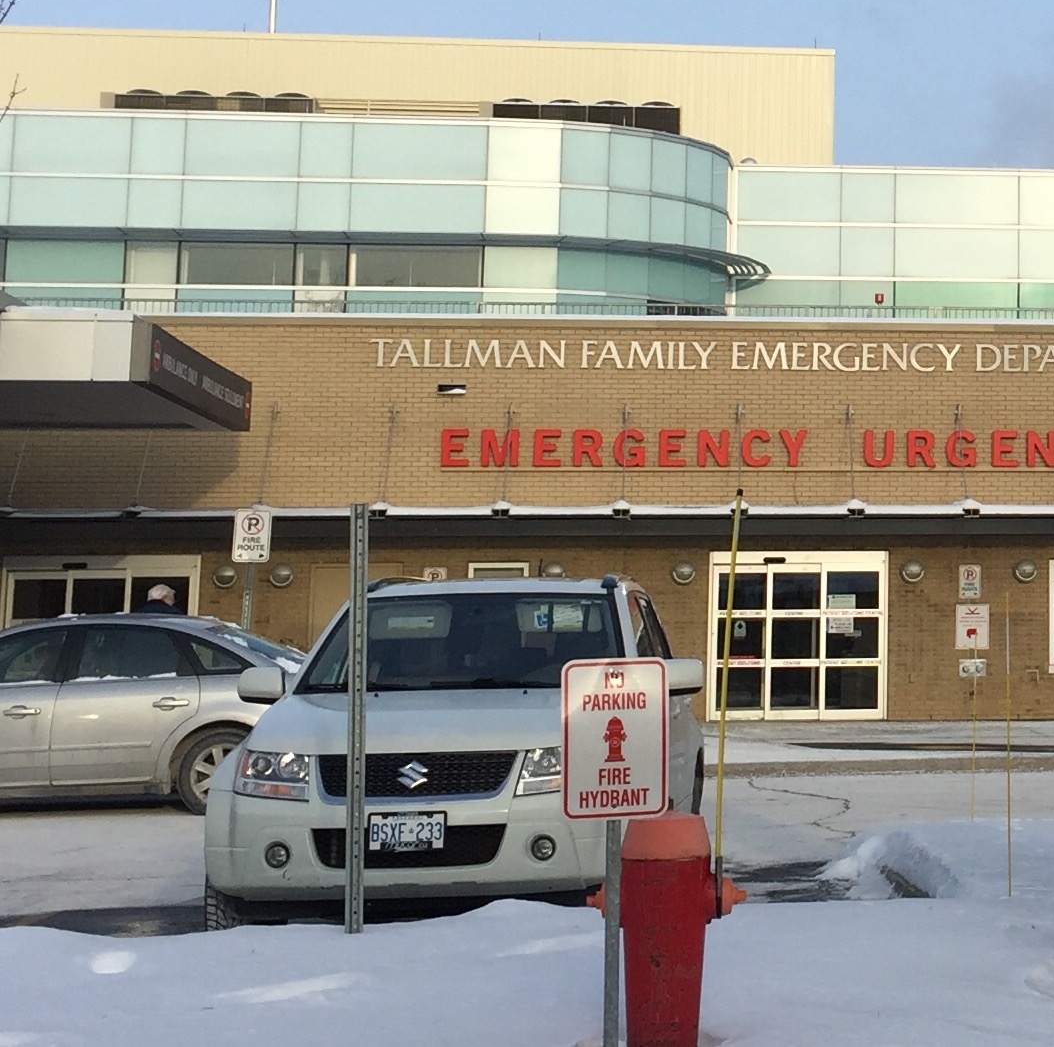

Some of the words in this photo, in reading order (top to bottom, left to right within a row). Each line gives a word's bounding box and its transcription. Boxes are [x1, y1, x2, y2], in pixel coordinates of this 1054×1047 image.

[370, 338, 567, 369] TALLMAN
[580, 340, 717, 370] FAMILY
[731, 341, 962, 372] EMERGENCY
[440, 428, 808, 468] EMERGENCY
[237, 544, 265, 552] ROUTE
[604, 671, 625, 690] NO
[582, 692, 647, 712] PARKING
[598, 767, 632, 786] FIRE
[579, 788, 650, 809] HYDRANT
